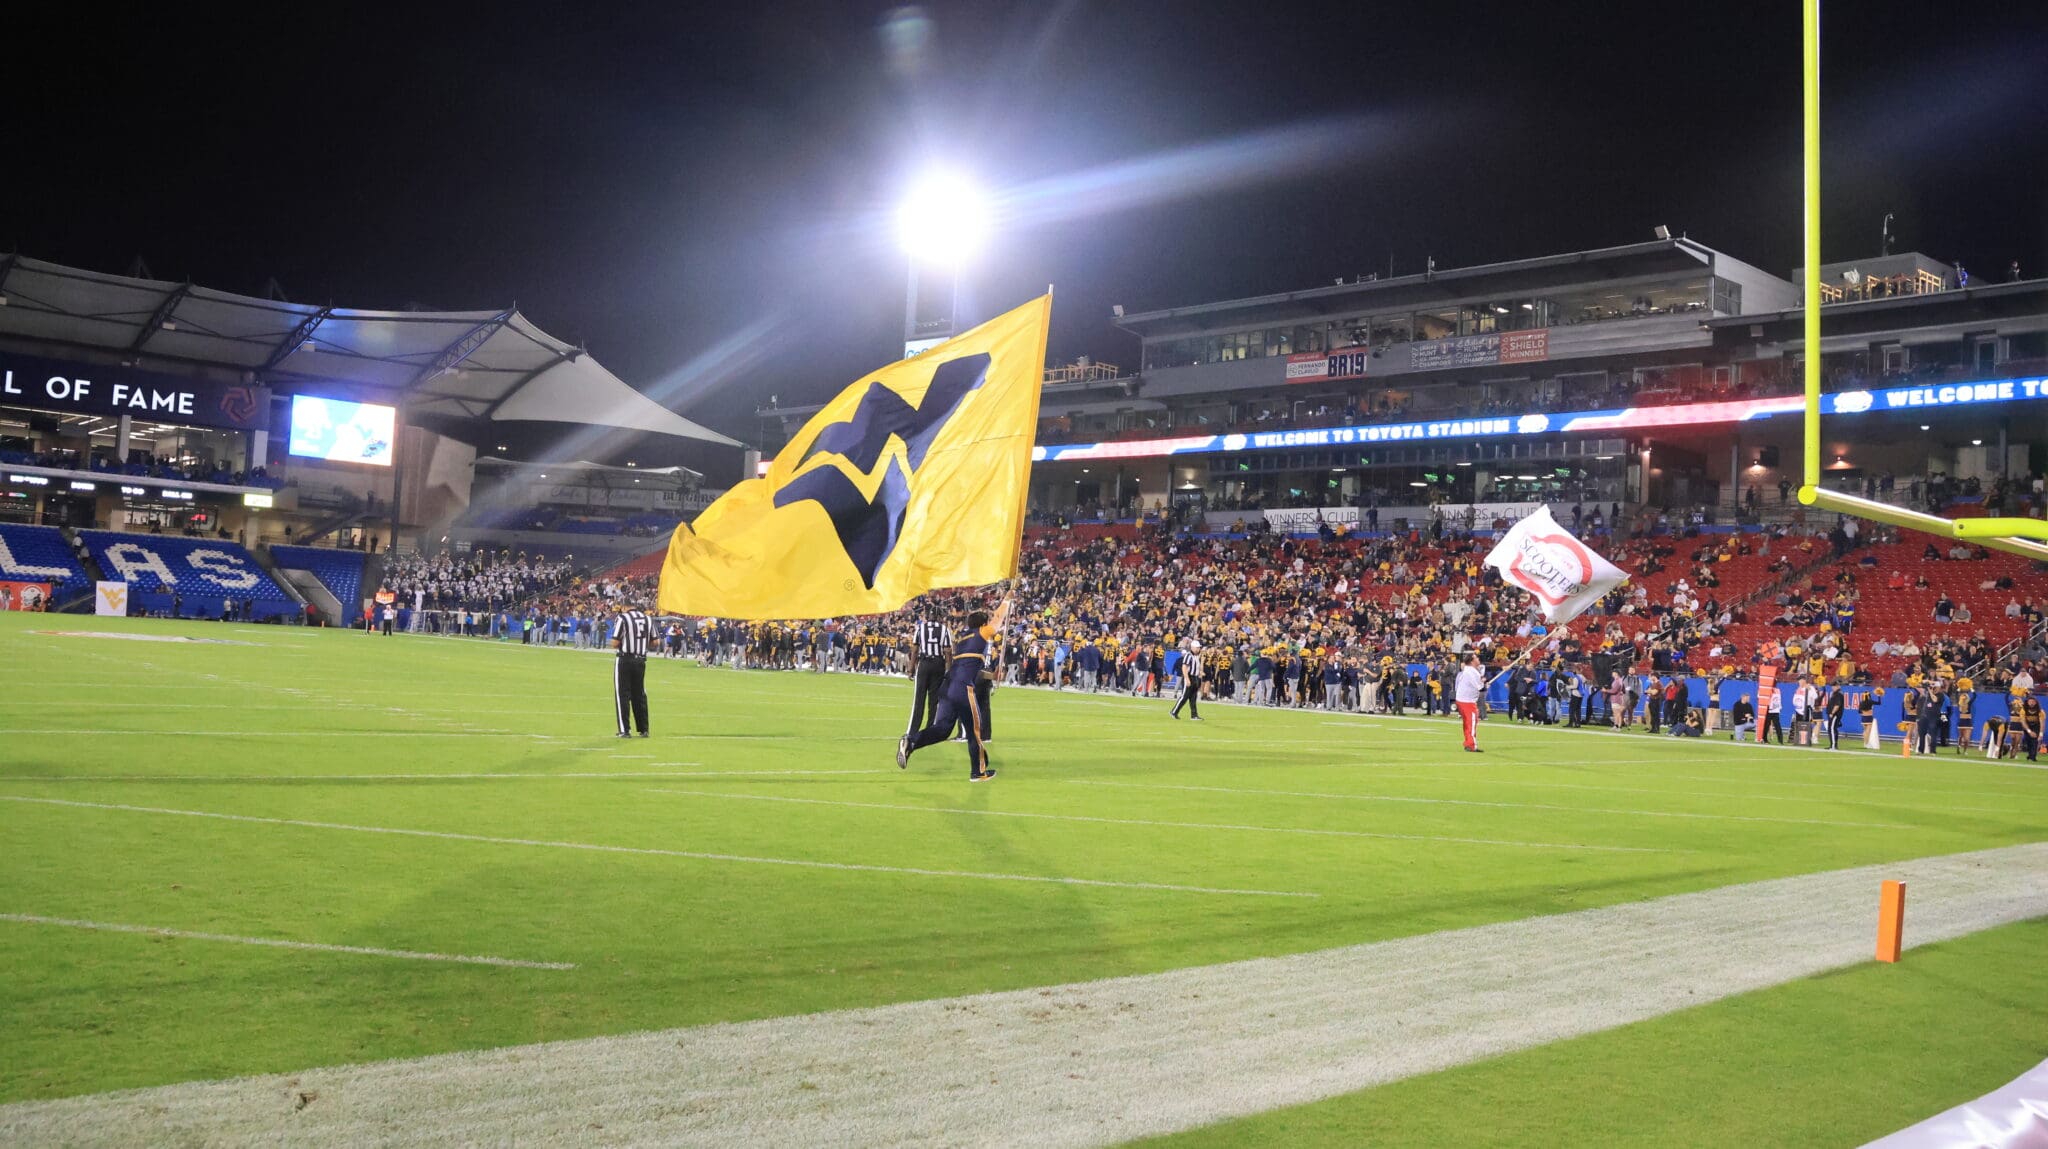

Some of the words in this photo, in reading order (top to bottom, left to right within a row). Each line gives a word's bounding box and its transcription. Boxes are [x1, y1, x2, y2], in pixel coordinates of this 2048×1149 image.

[1510, 339, 1545, 351] SHIELD
[1509, 350, 1545, 359] WINNERS
[46, 376, 91, 401] OF
[112, 384, 195, 415] FAME
[1886, 382, 2014, 407] WELCOME
[1254, 430, 1328, 447] WELCOME
[1333, 430, 1353, 442] TO
[1358, 425, 1424, 441] TOYOTA
[1428, 419, 1510, 437] STADIUM
[1265, 512, 1315, 526] WINNERS
[1327, 511, 1357, 523] CLUB
[927, 627, 938, 642] L
